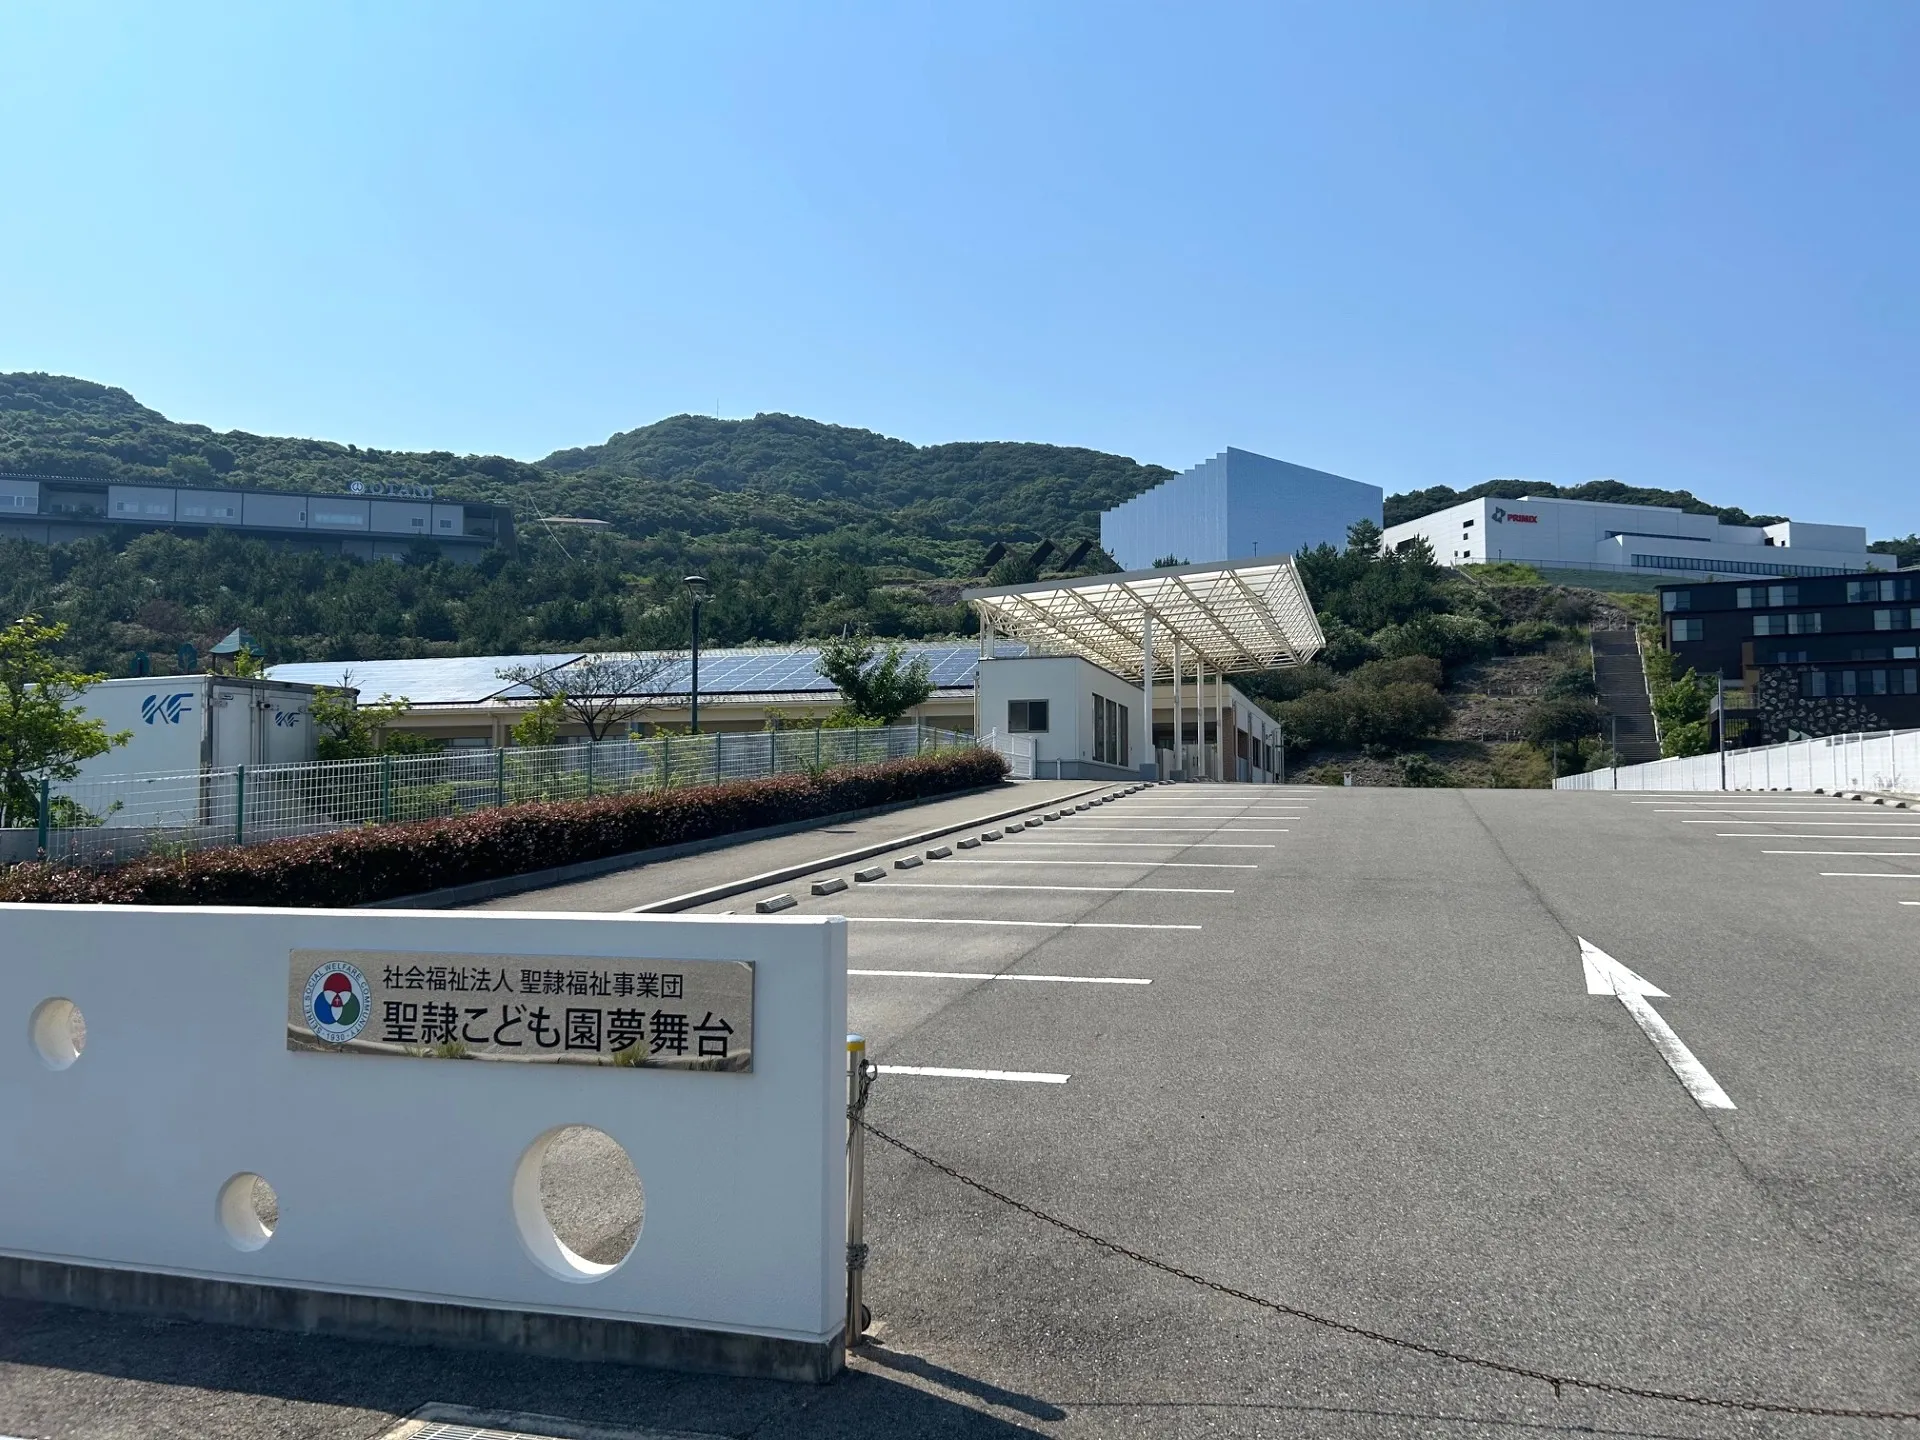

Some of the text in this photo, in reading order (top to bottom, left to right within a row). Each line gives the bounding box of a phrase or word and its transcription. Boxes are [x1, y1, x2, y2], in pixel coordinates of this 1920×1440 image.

[370, 482, 434, 499] OTANI
[1507, 513, 1538, 524] PRIMIX
[382, 964, 684, 999] 社会福祉法人 聖隷福祉事業団
[304, 962, 371, 1037] SEIREI SOCIAL WELFARE COMMUNITY
[326, 1033, 345, 1042] 1930
[382, 1000, 735, 1058] 聖隷こども園夢舞台
